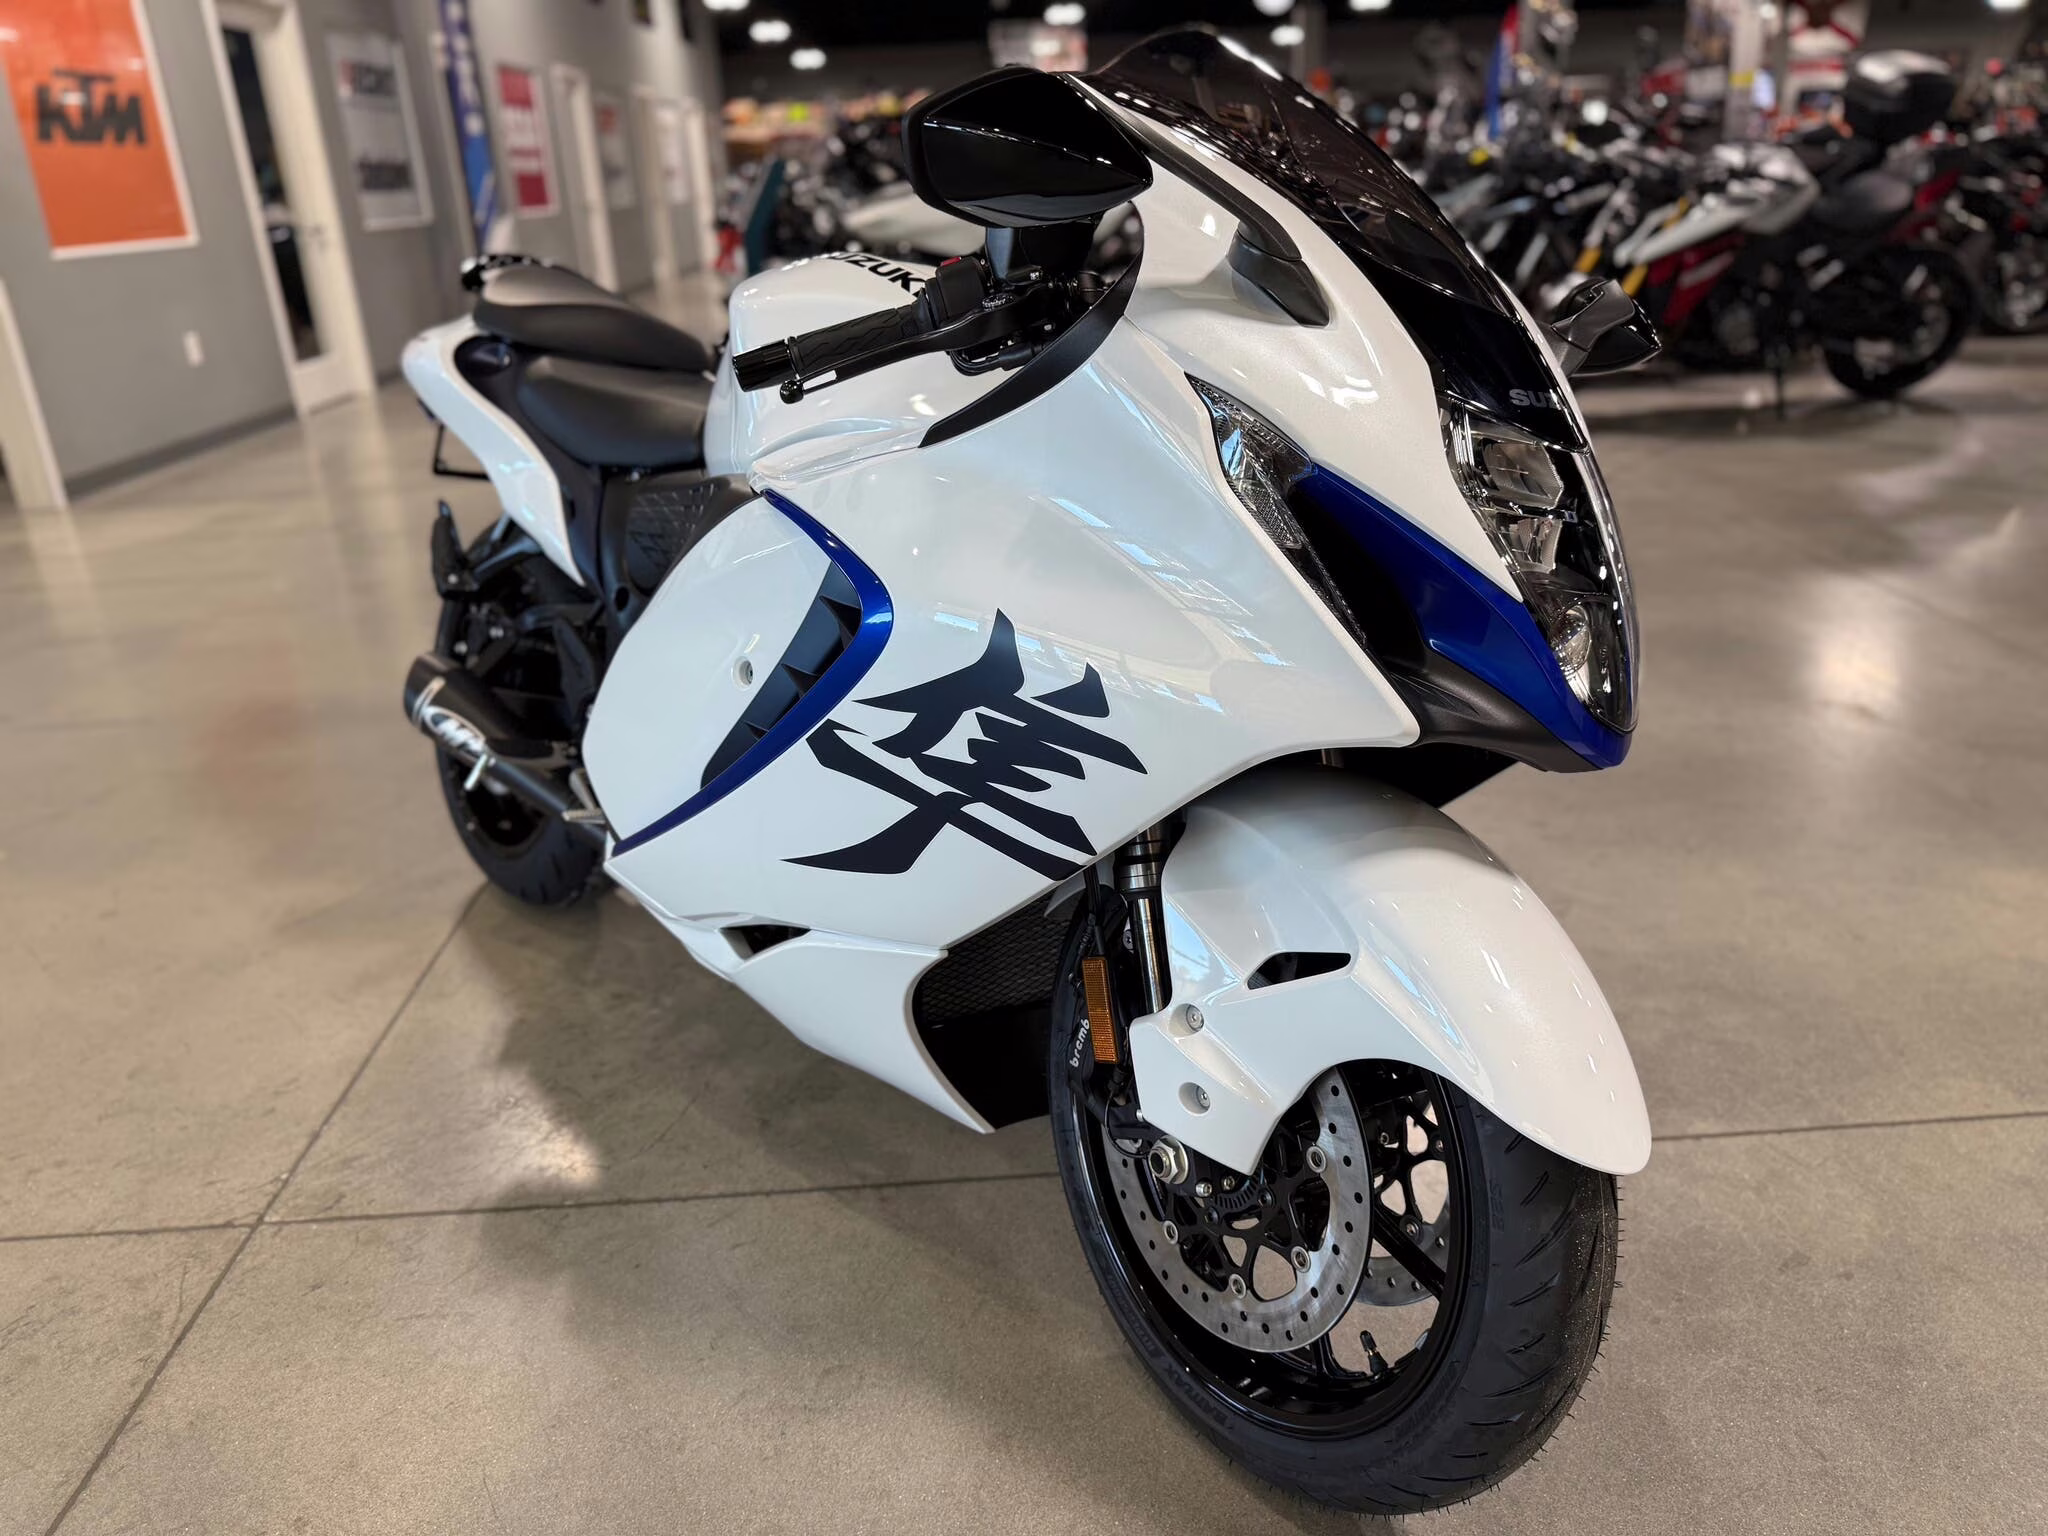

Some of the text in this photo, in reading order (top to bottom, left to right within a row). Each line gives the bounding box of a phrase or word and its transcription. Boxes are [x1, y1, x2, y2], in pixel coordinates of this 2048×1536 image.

[36, 68, 147, 145] KTM
[828, 254, 924, 297] UZUK
[779, 607, 1149, 881] 隼
